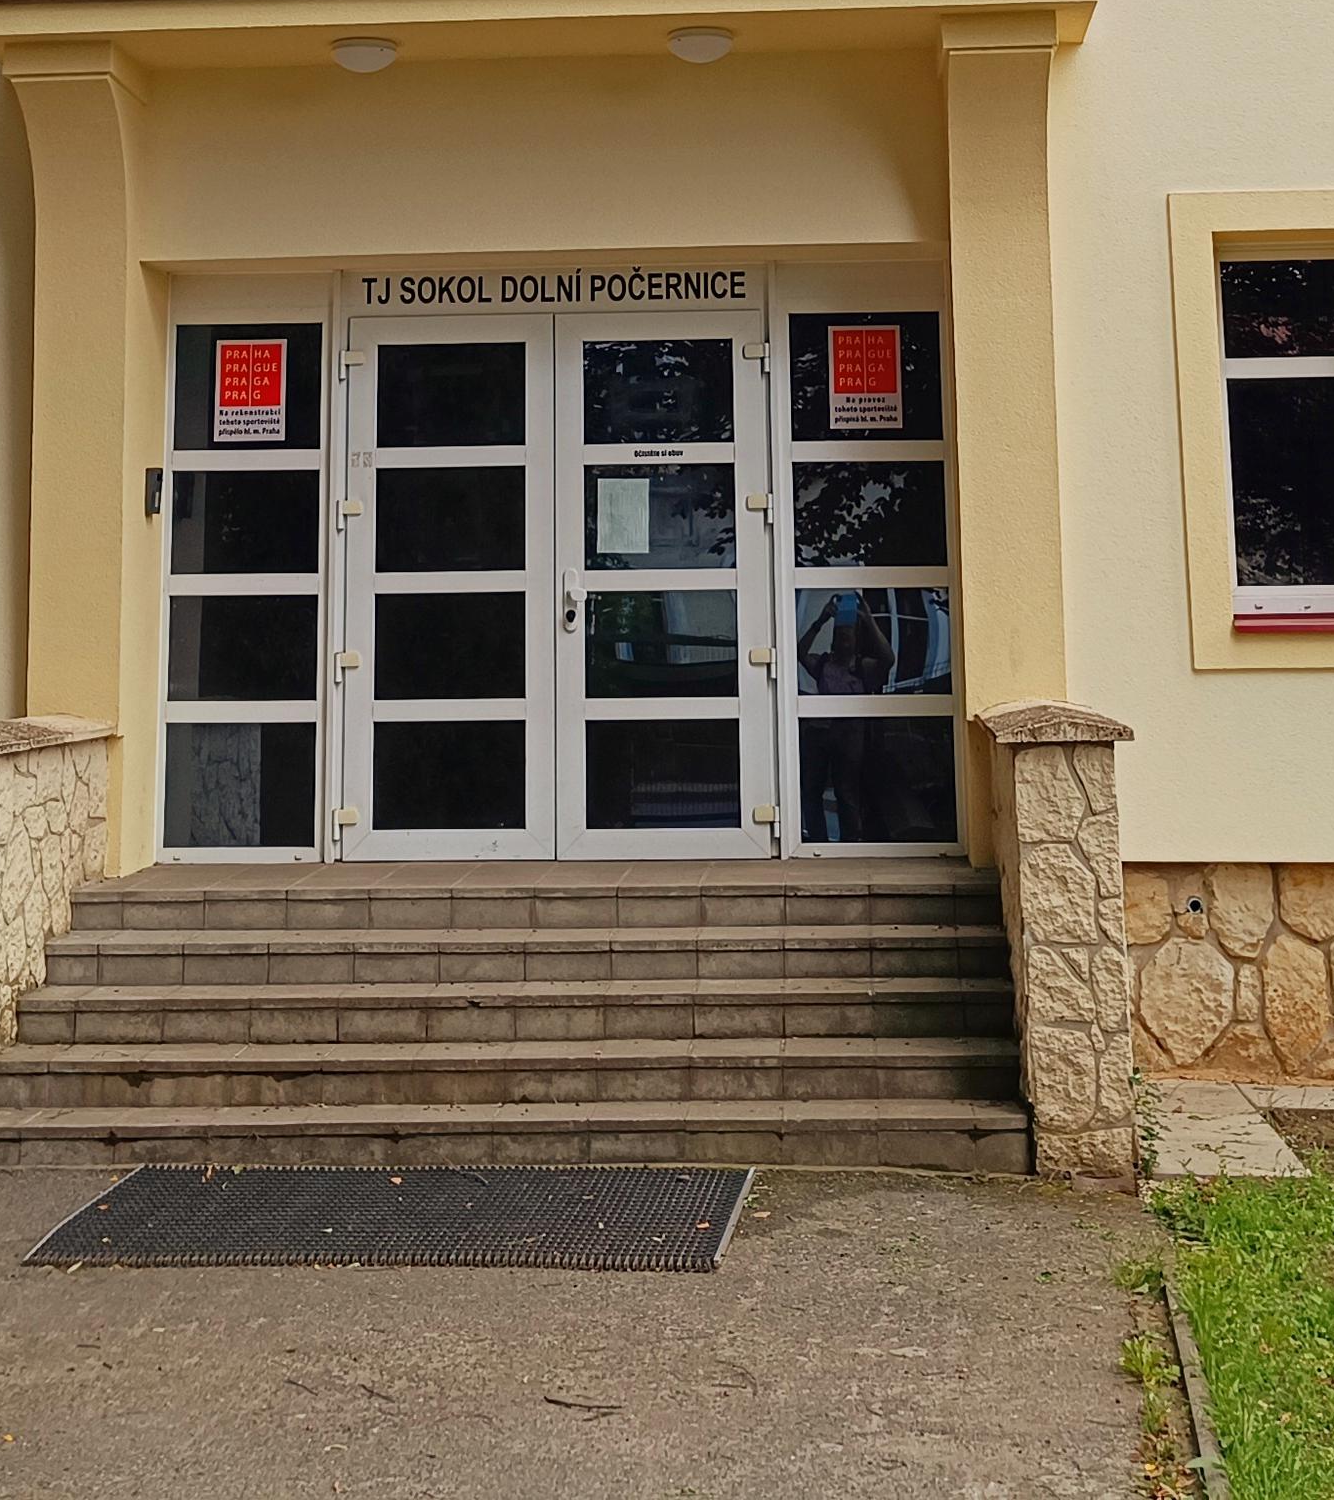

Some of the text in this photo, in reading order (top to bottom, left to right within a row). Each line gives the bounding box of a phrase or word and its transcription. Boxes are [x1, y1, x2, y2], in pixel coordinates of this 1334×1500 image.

[362, 266, 746, 304] TJ SOKOL DOLNÍ POČERNICE
